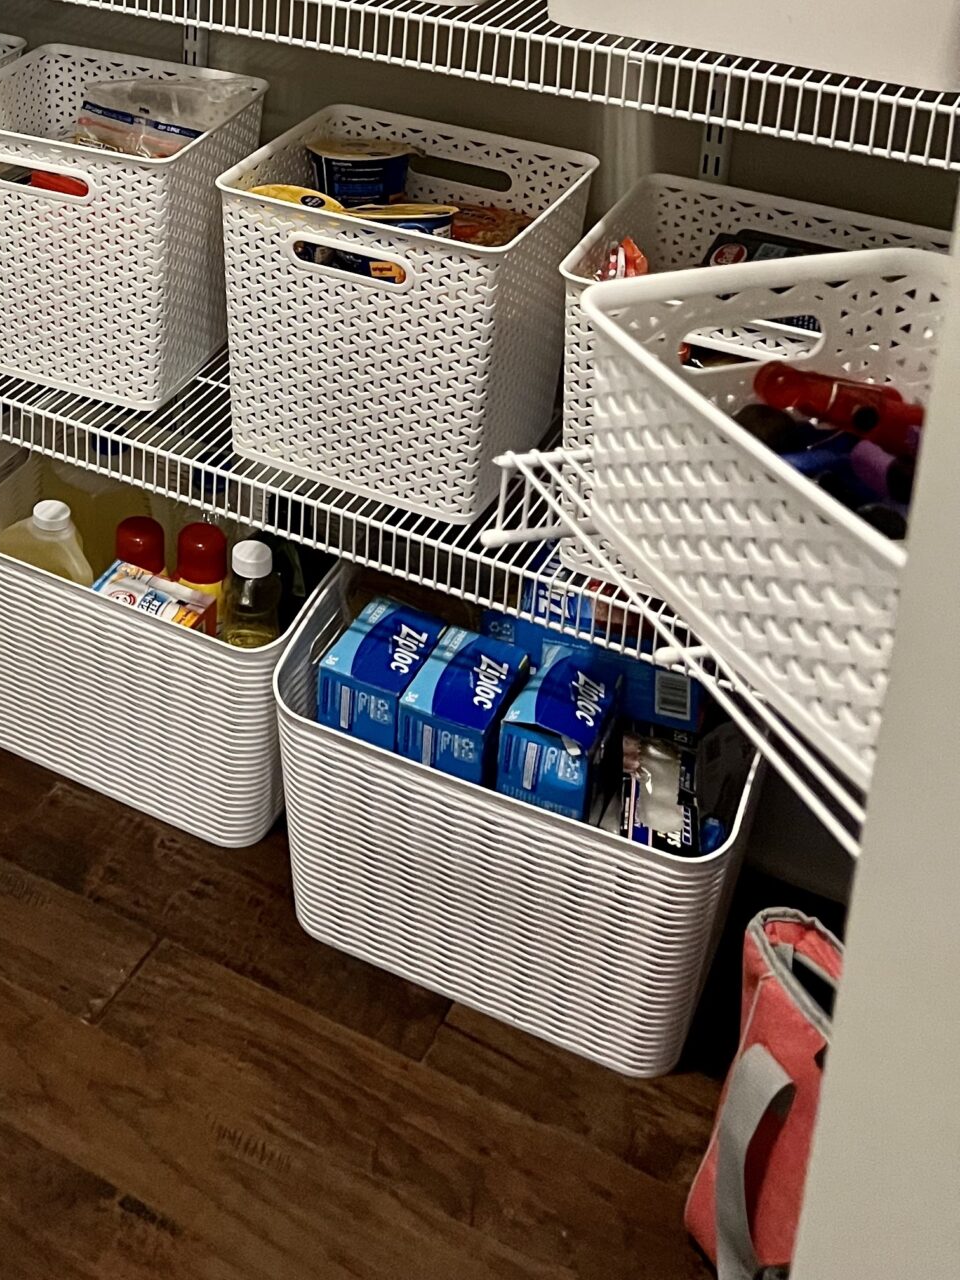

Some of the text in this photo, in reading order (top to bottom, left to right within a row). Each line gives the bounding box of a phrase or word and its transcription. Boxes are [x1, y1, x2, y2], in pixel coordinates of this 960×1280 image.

[390, 623, 429, 675] Ziploc
[473, 654, 509, 710] Ziploc
[572, 670, 606, 728] Ziploc
